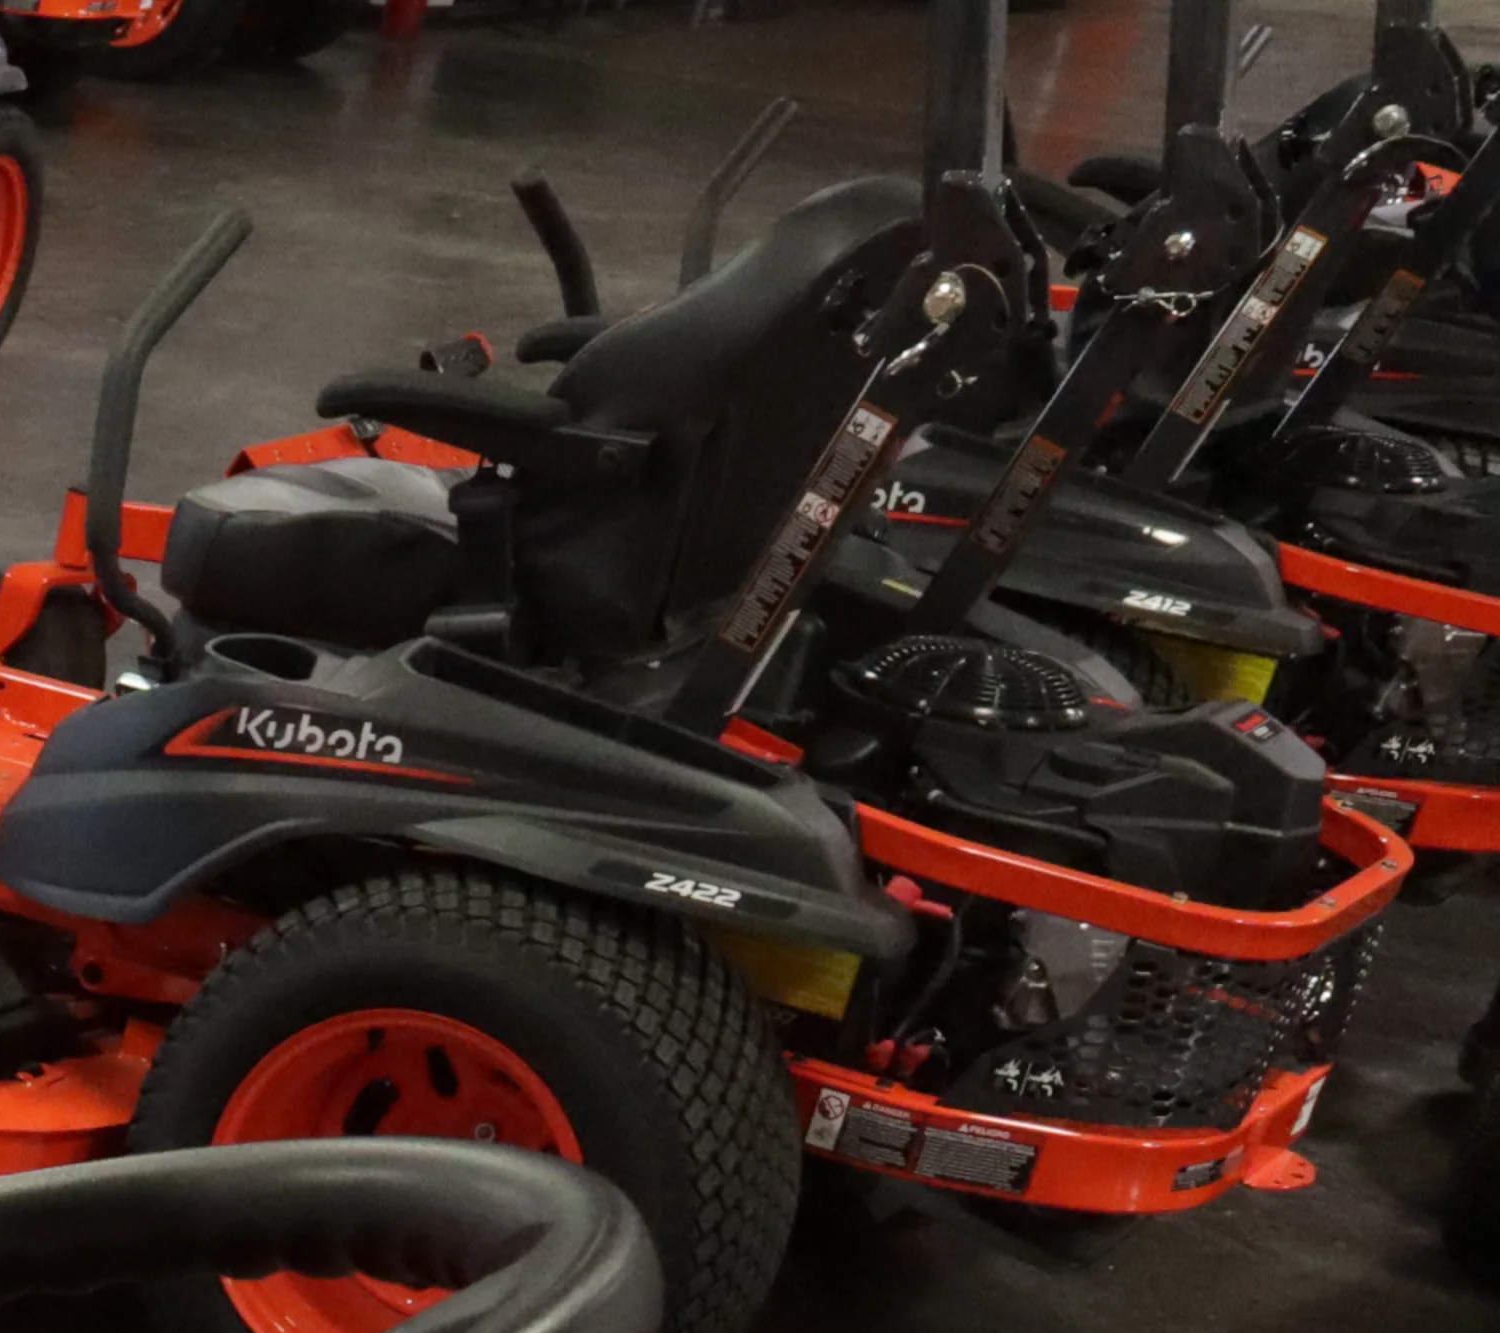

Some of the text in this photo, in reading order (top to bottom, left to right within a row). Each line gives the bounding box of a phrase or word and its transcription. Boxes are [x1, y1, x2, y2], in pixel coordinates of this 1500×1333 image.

[1122, 589, 1191, 617] Z412
[237, 705, 402, 764] Kubota
[642, 871, 742, 908] Z422
